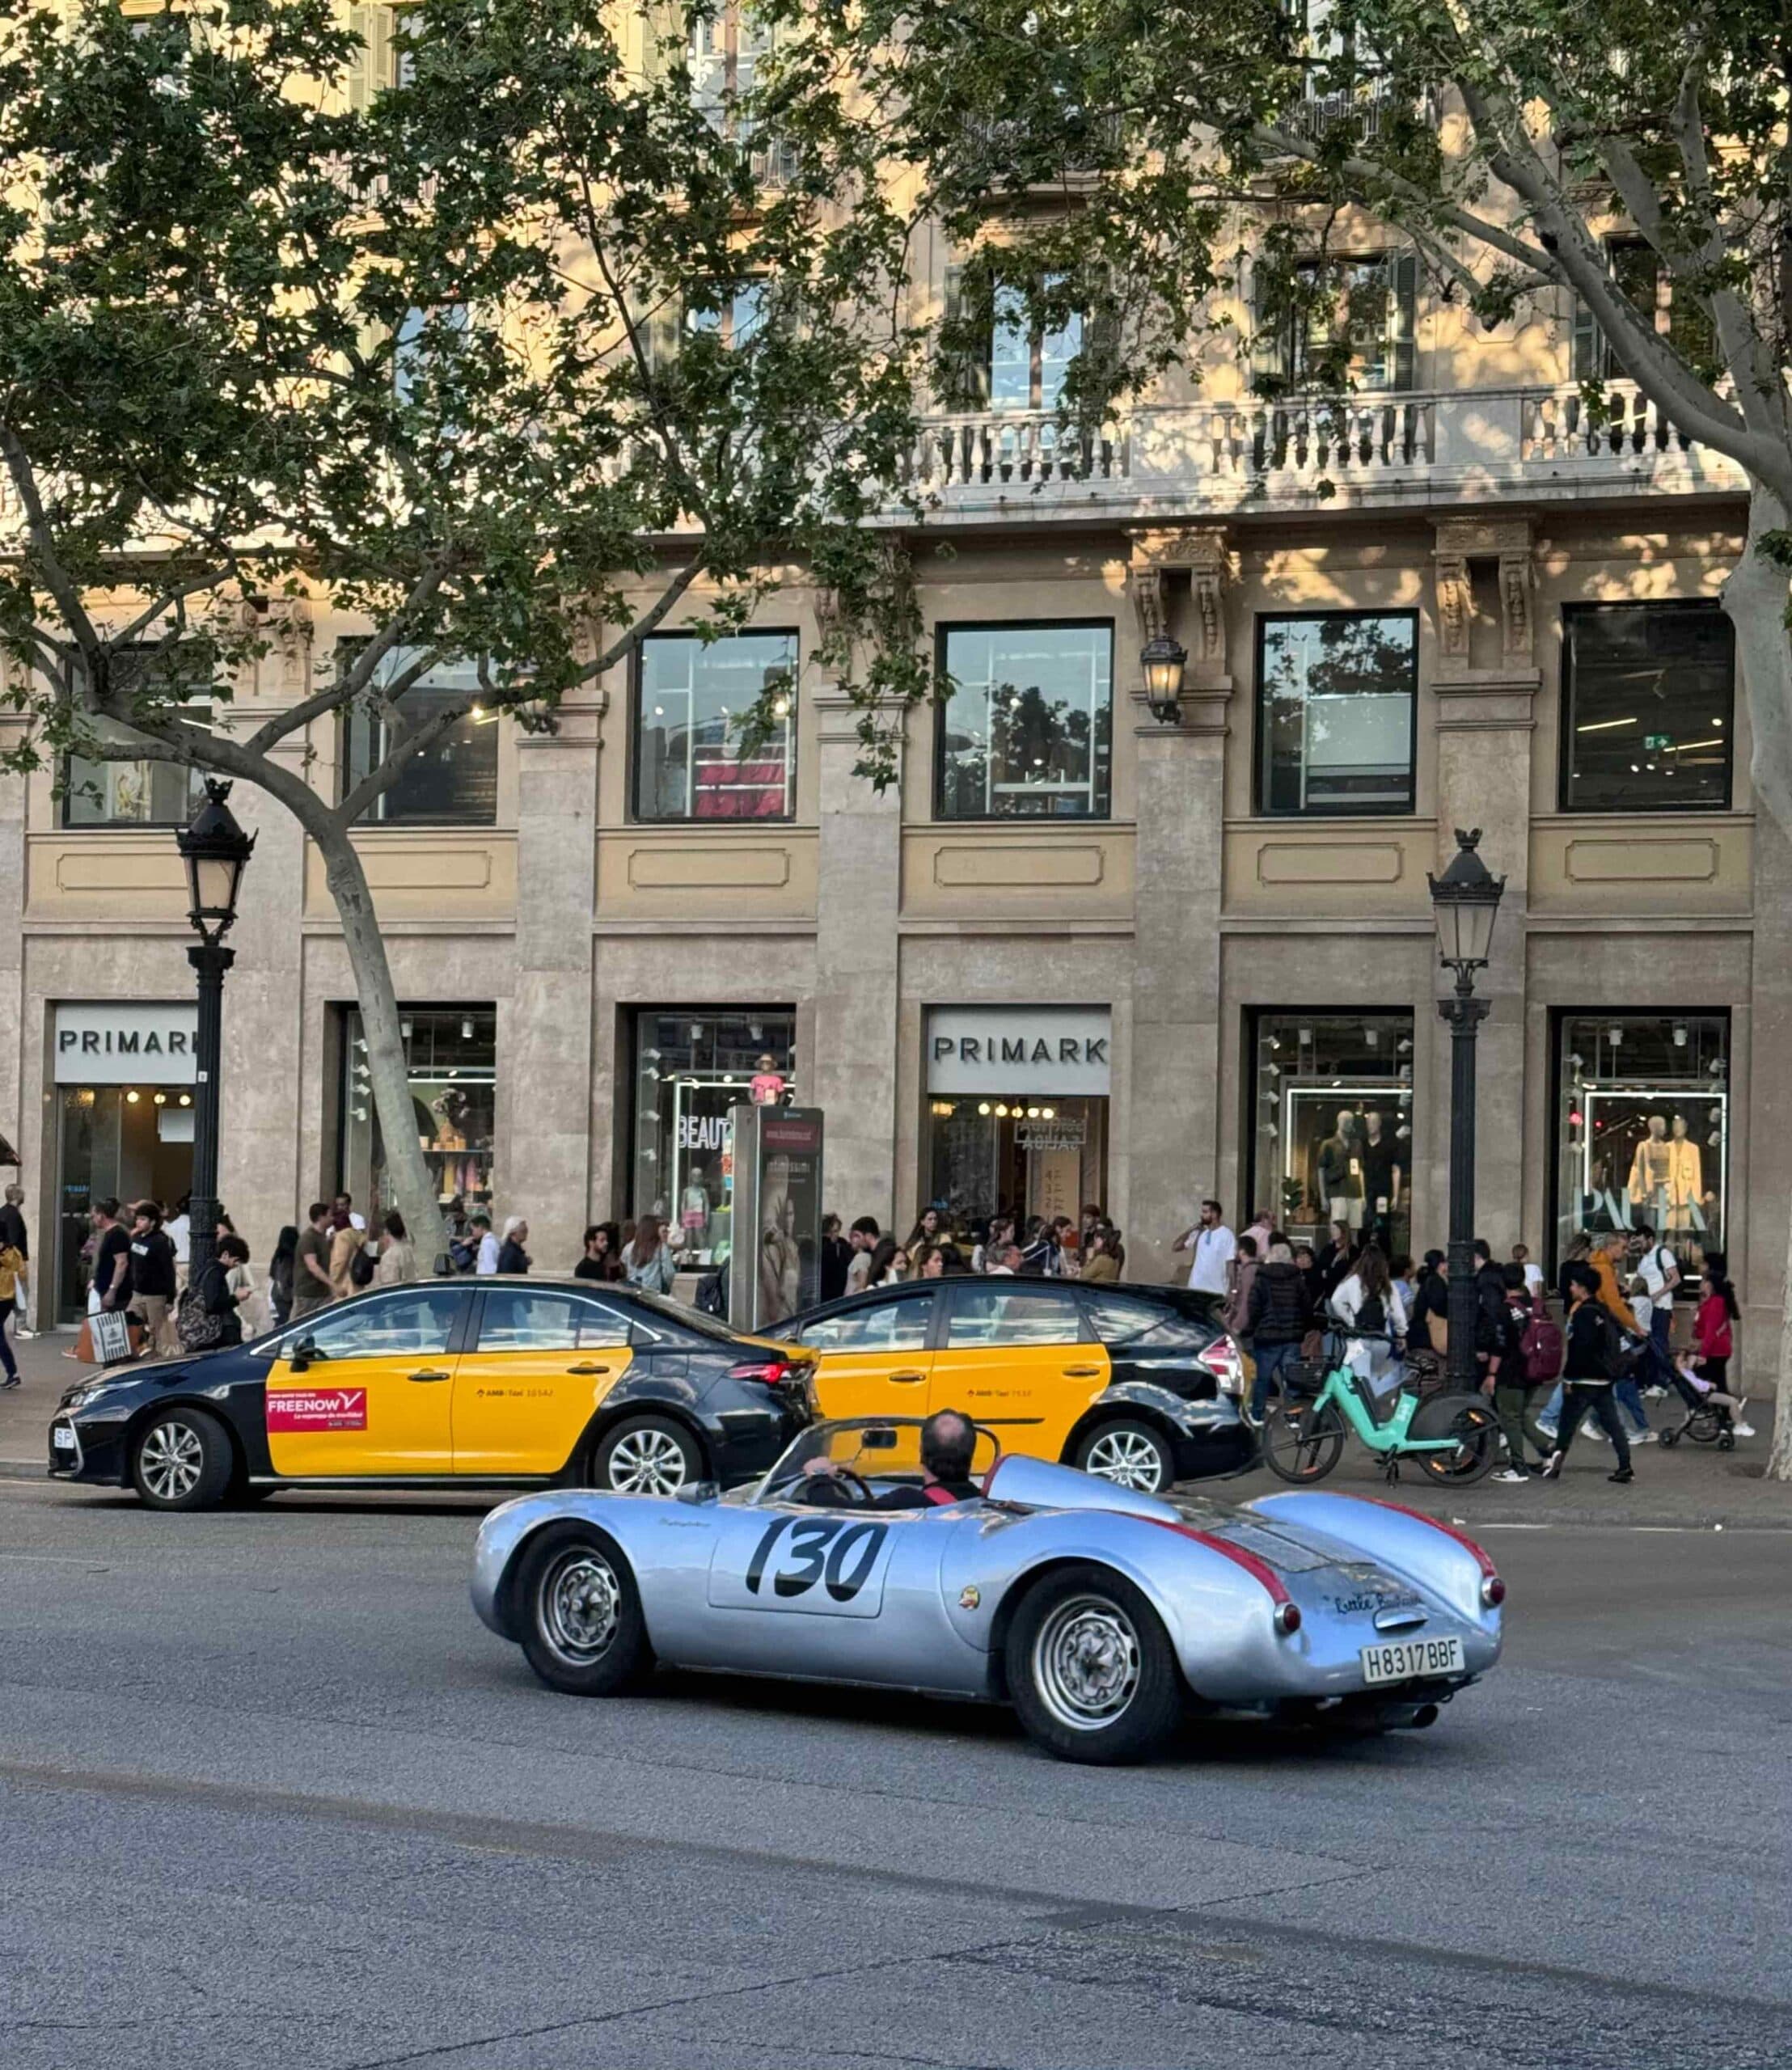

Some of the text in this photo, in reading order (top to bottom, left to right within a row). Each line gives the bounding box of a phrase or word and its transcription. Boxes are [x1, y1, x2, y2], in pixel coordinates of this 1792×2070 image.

[934, 1037, 1107, 1062] PRIMARK
[268, 1399, 340, 1413] FREENOW
[746, 1514, 889, 1603] 130
